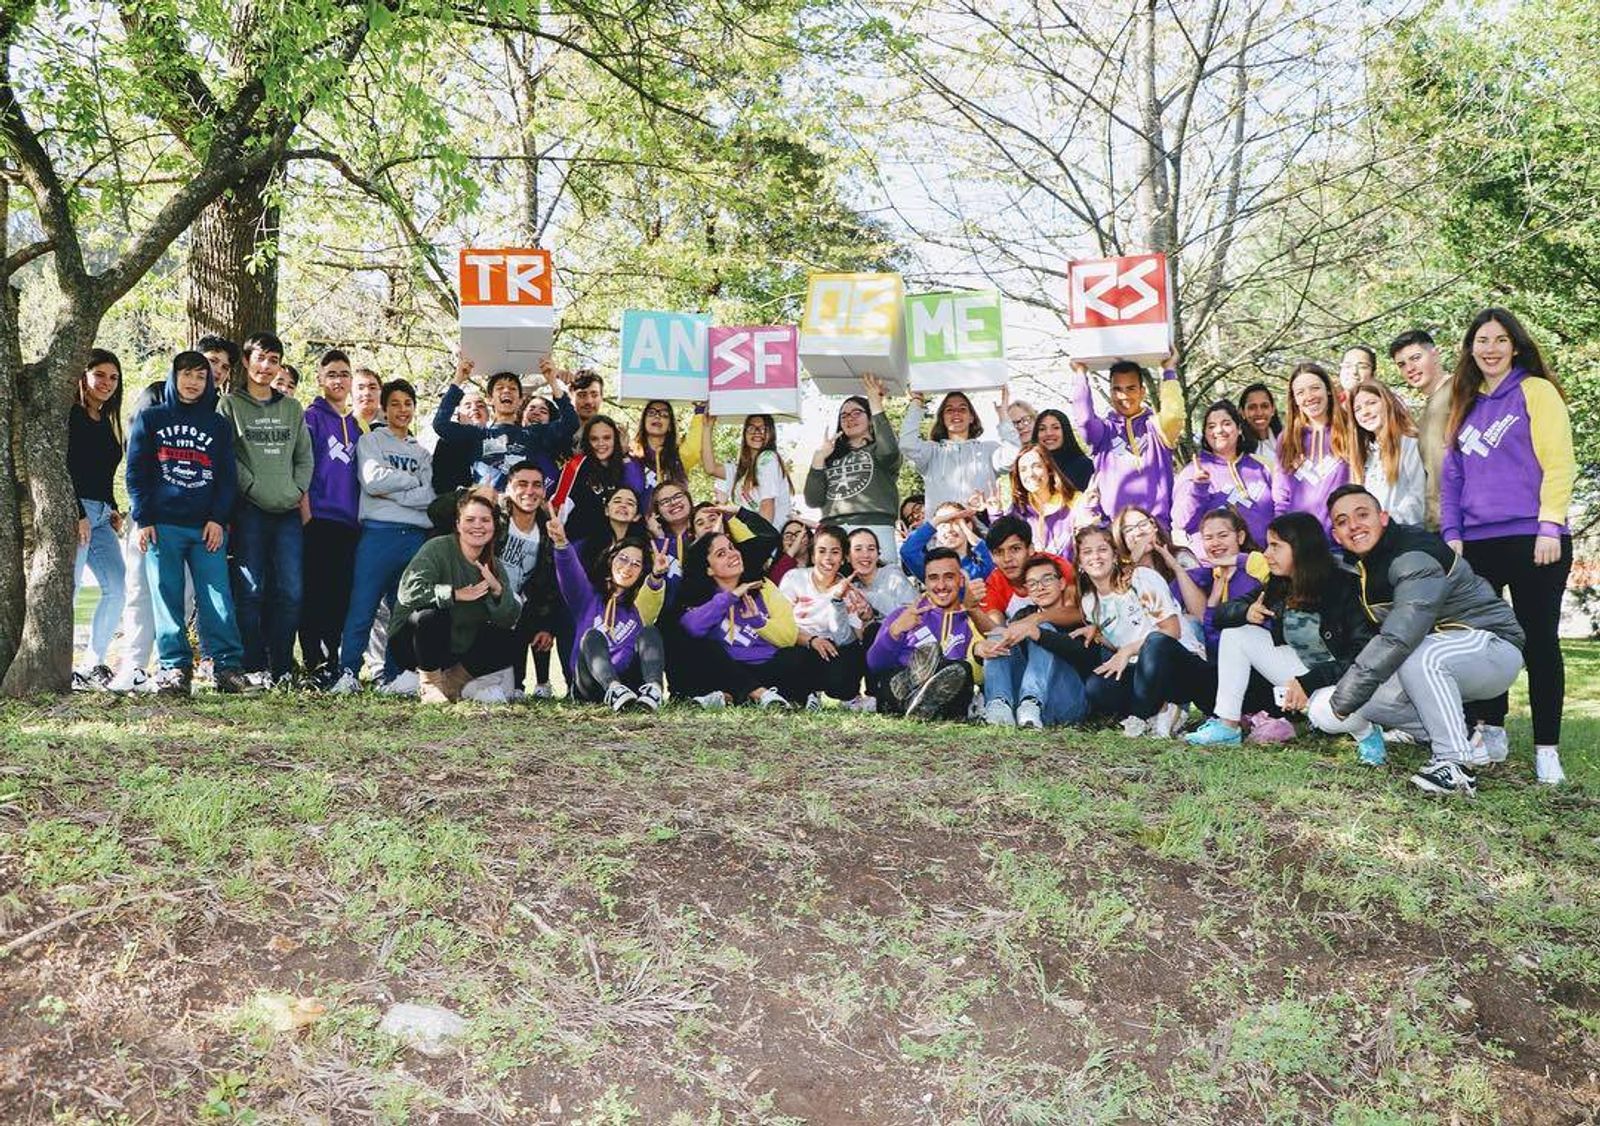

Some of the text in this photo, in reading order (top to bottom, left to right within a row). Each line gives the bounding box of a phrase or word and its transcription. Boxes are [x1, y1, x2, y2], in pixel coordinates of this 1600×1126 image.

[465, 255, 544, 302] TR
[1073, 258, 1161, 324] RS
[628, 318, 706, 372] AN
[911, 299, 999, 356] ME
[713, 330, 791, 386] SF
[157, 425, 213, 446] TIFFOSI
[388, 454, 418, 473] NYC
